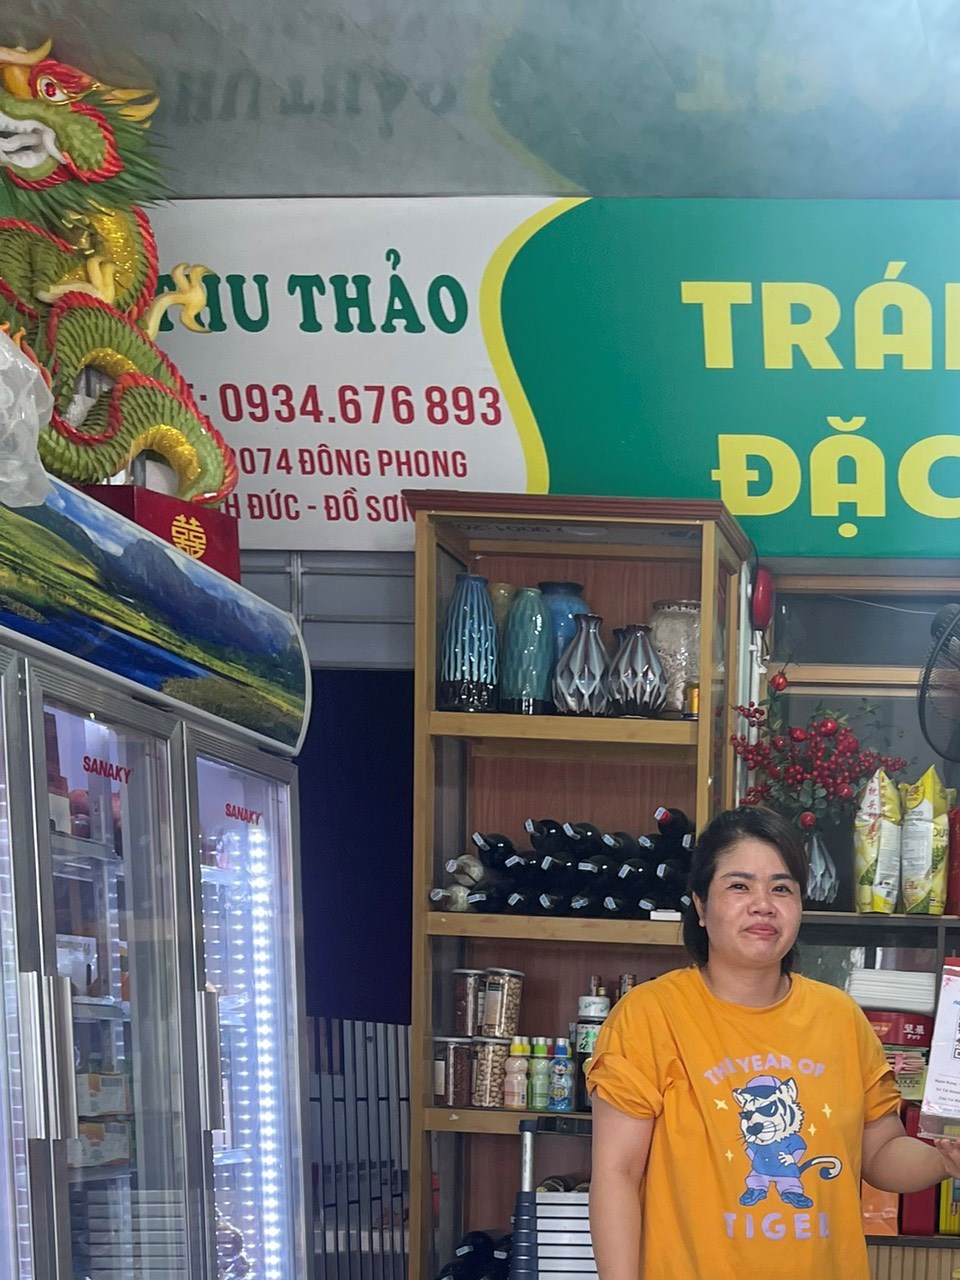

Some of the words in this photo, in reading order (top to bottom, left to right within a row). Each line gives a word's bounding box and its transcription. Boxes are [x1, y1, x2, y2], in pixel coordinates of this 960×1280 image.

[286, 249, 469, 334] THẢO
[230, 447, 293, 475] 074
[298, 443, 371, 476] ĐÔNG
[377, 449, 468, 478] PHONG
[247, 488, 300, 520] ĐỨC
[324, 487, 359, 522] ĐỒ
[83, 755, 132, 785] SANAKY
[225, 803, 262, 826] SANAKY
[736, 1054, 792, 1074] YEAR
[797, 1058, 826, 1078] OF
